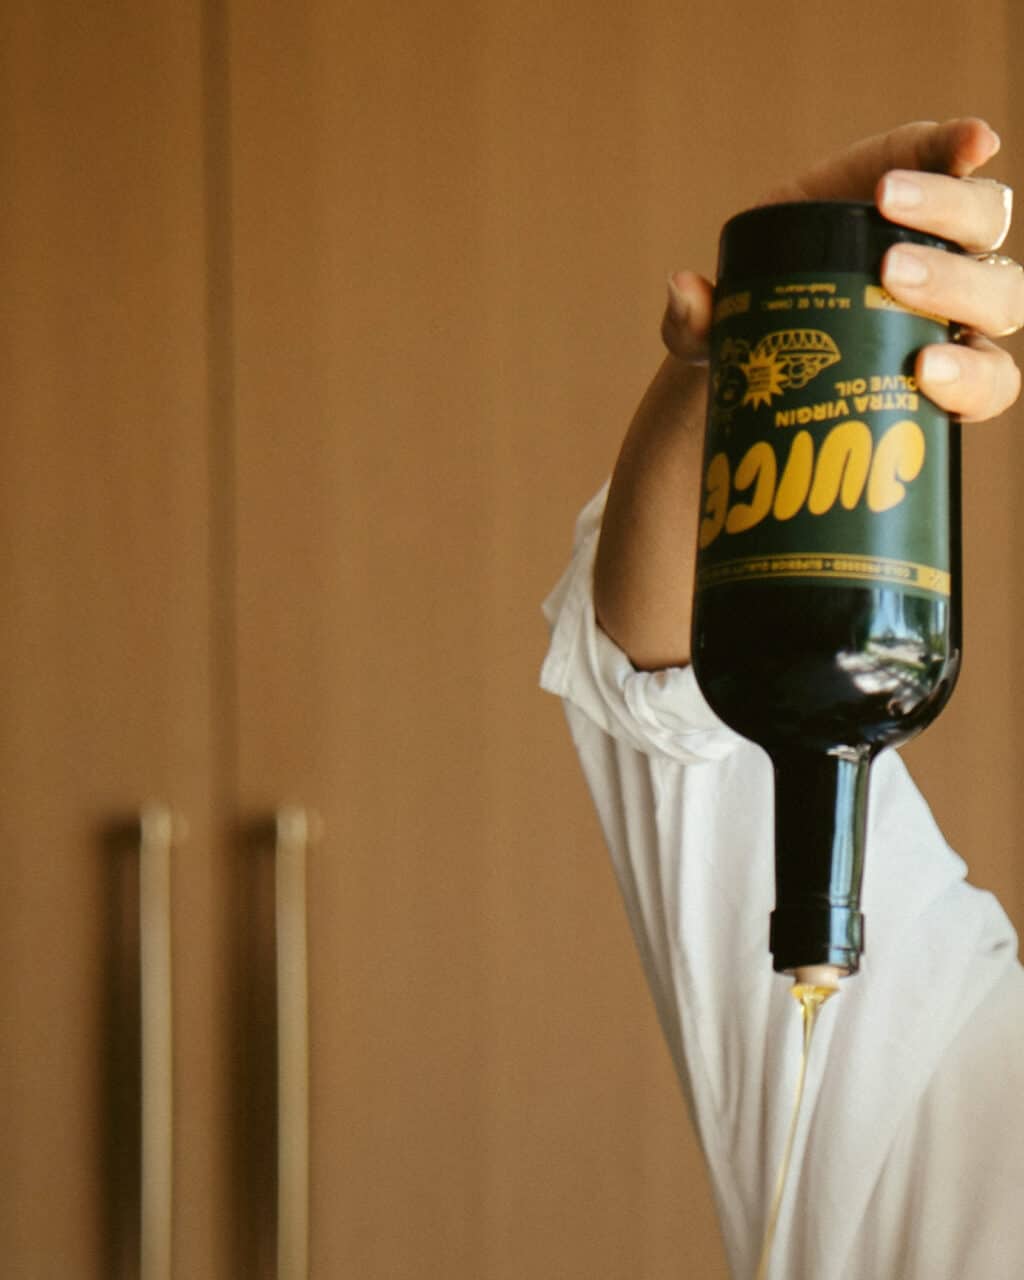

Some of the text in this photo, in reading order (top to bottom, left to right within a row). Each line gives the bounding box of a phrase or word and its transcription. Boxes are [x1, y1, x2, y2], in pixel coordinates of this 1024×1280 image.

[835, 375, 917, 397] OLIVE OIL
[775, 393, 919, 427] EXTRA VIRGIN
